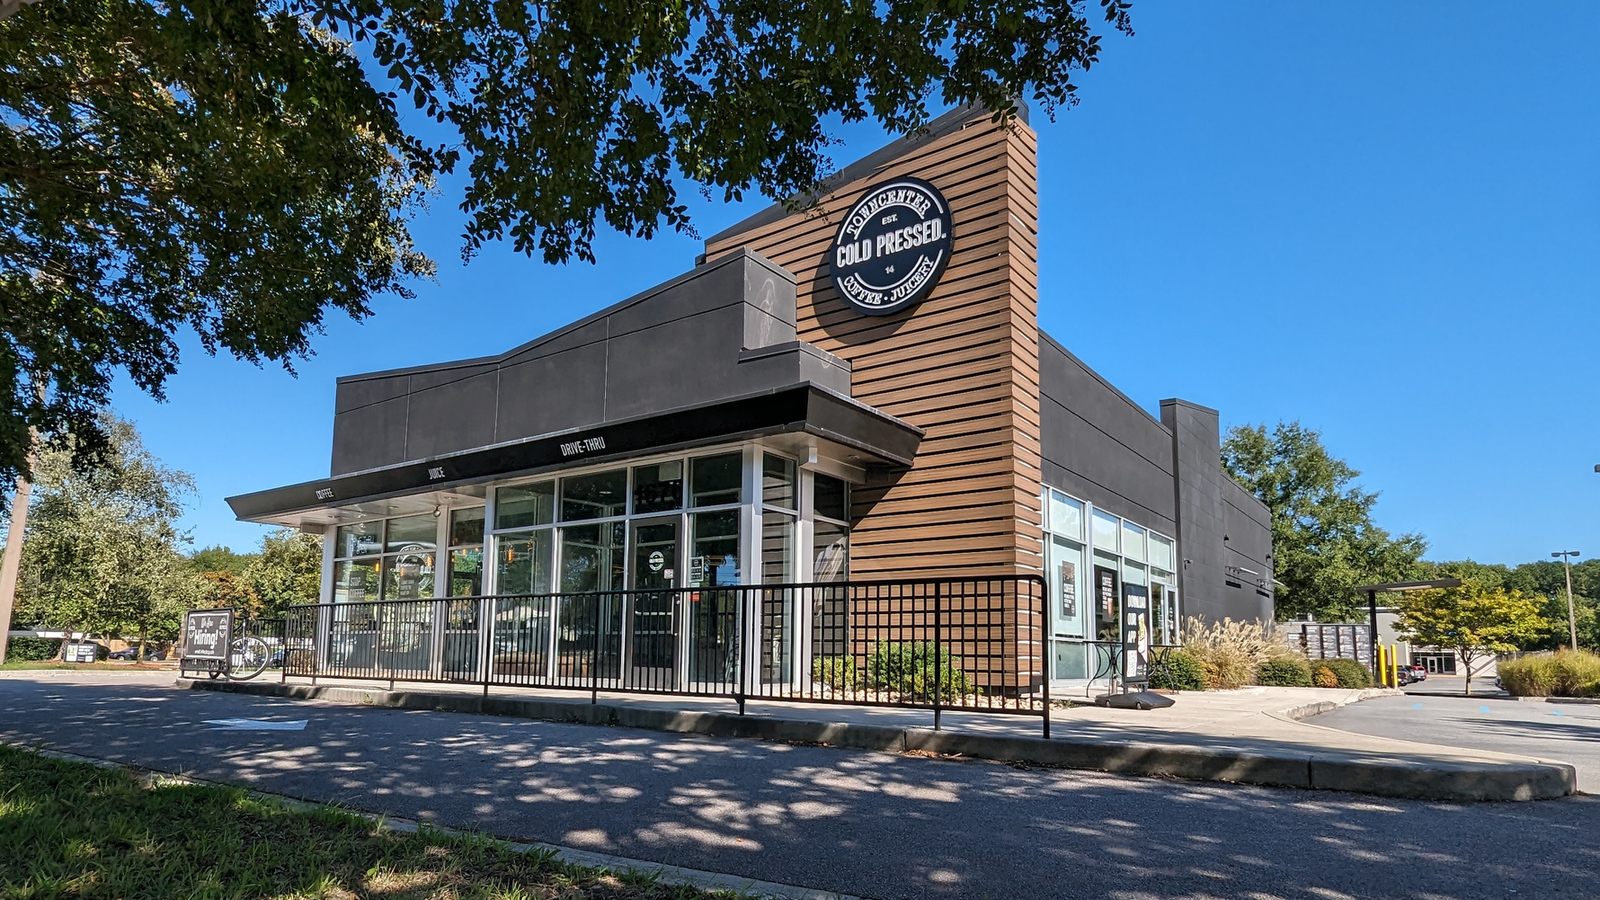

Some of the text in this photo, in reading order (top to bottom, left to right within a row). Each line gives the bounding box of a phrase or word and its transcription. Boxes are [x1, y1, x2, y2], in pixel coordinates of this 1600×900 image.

[846, 189, 931, 236] TOWNCENTER
[881, 213, 898, 226] EST.
[836, 217, 947, 268] COLD PRESSED.
[843, 256, 934, 305] COFFEE JUICERY
[560, 436, 606, 456] DRIVE-THRU
[428, 466, 446, 480] JUICE
[315, 487, 334, 500] COFFEE
[193, 629, 218, 649] Hiring!
